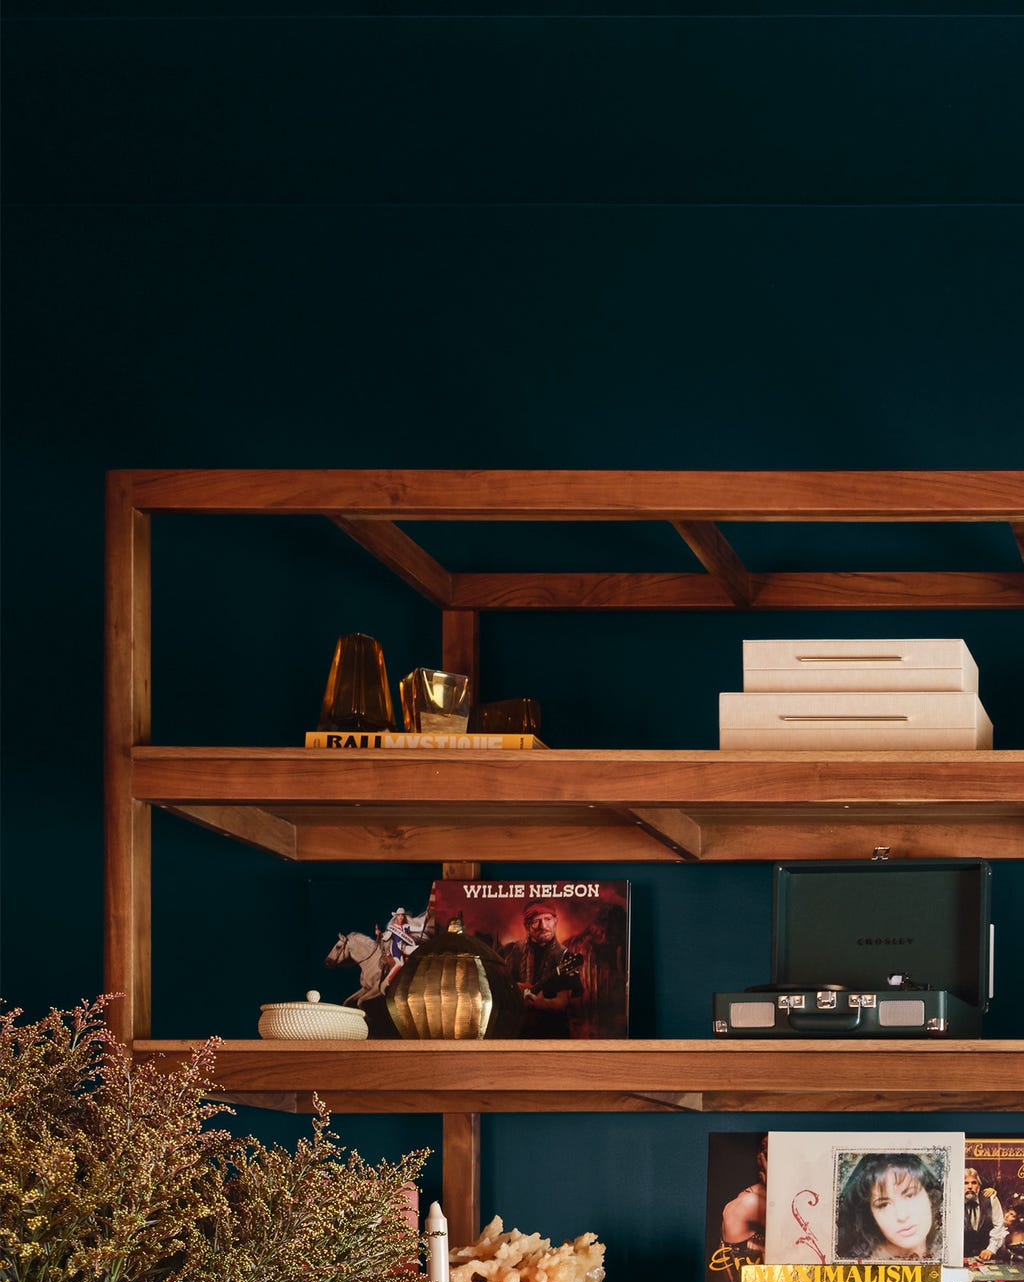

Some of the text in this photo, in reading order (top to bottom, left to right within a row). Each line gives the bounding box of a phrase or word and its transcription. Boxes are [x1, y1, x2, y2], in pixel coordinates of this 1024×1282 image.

[463, 884, 600, 898] WILLIE NELSON
[856, 937, 913, 946] CROSLEY
